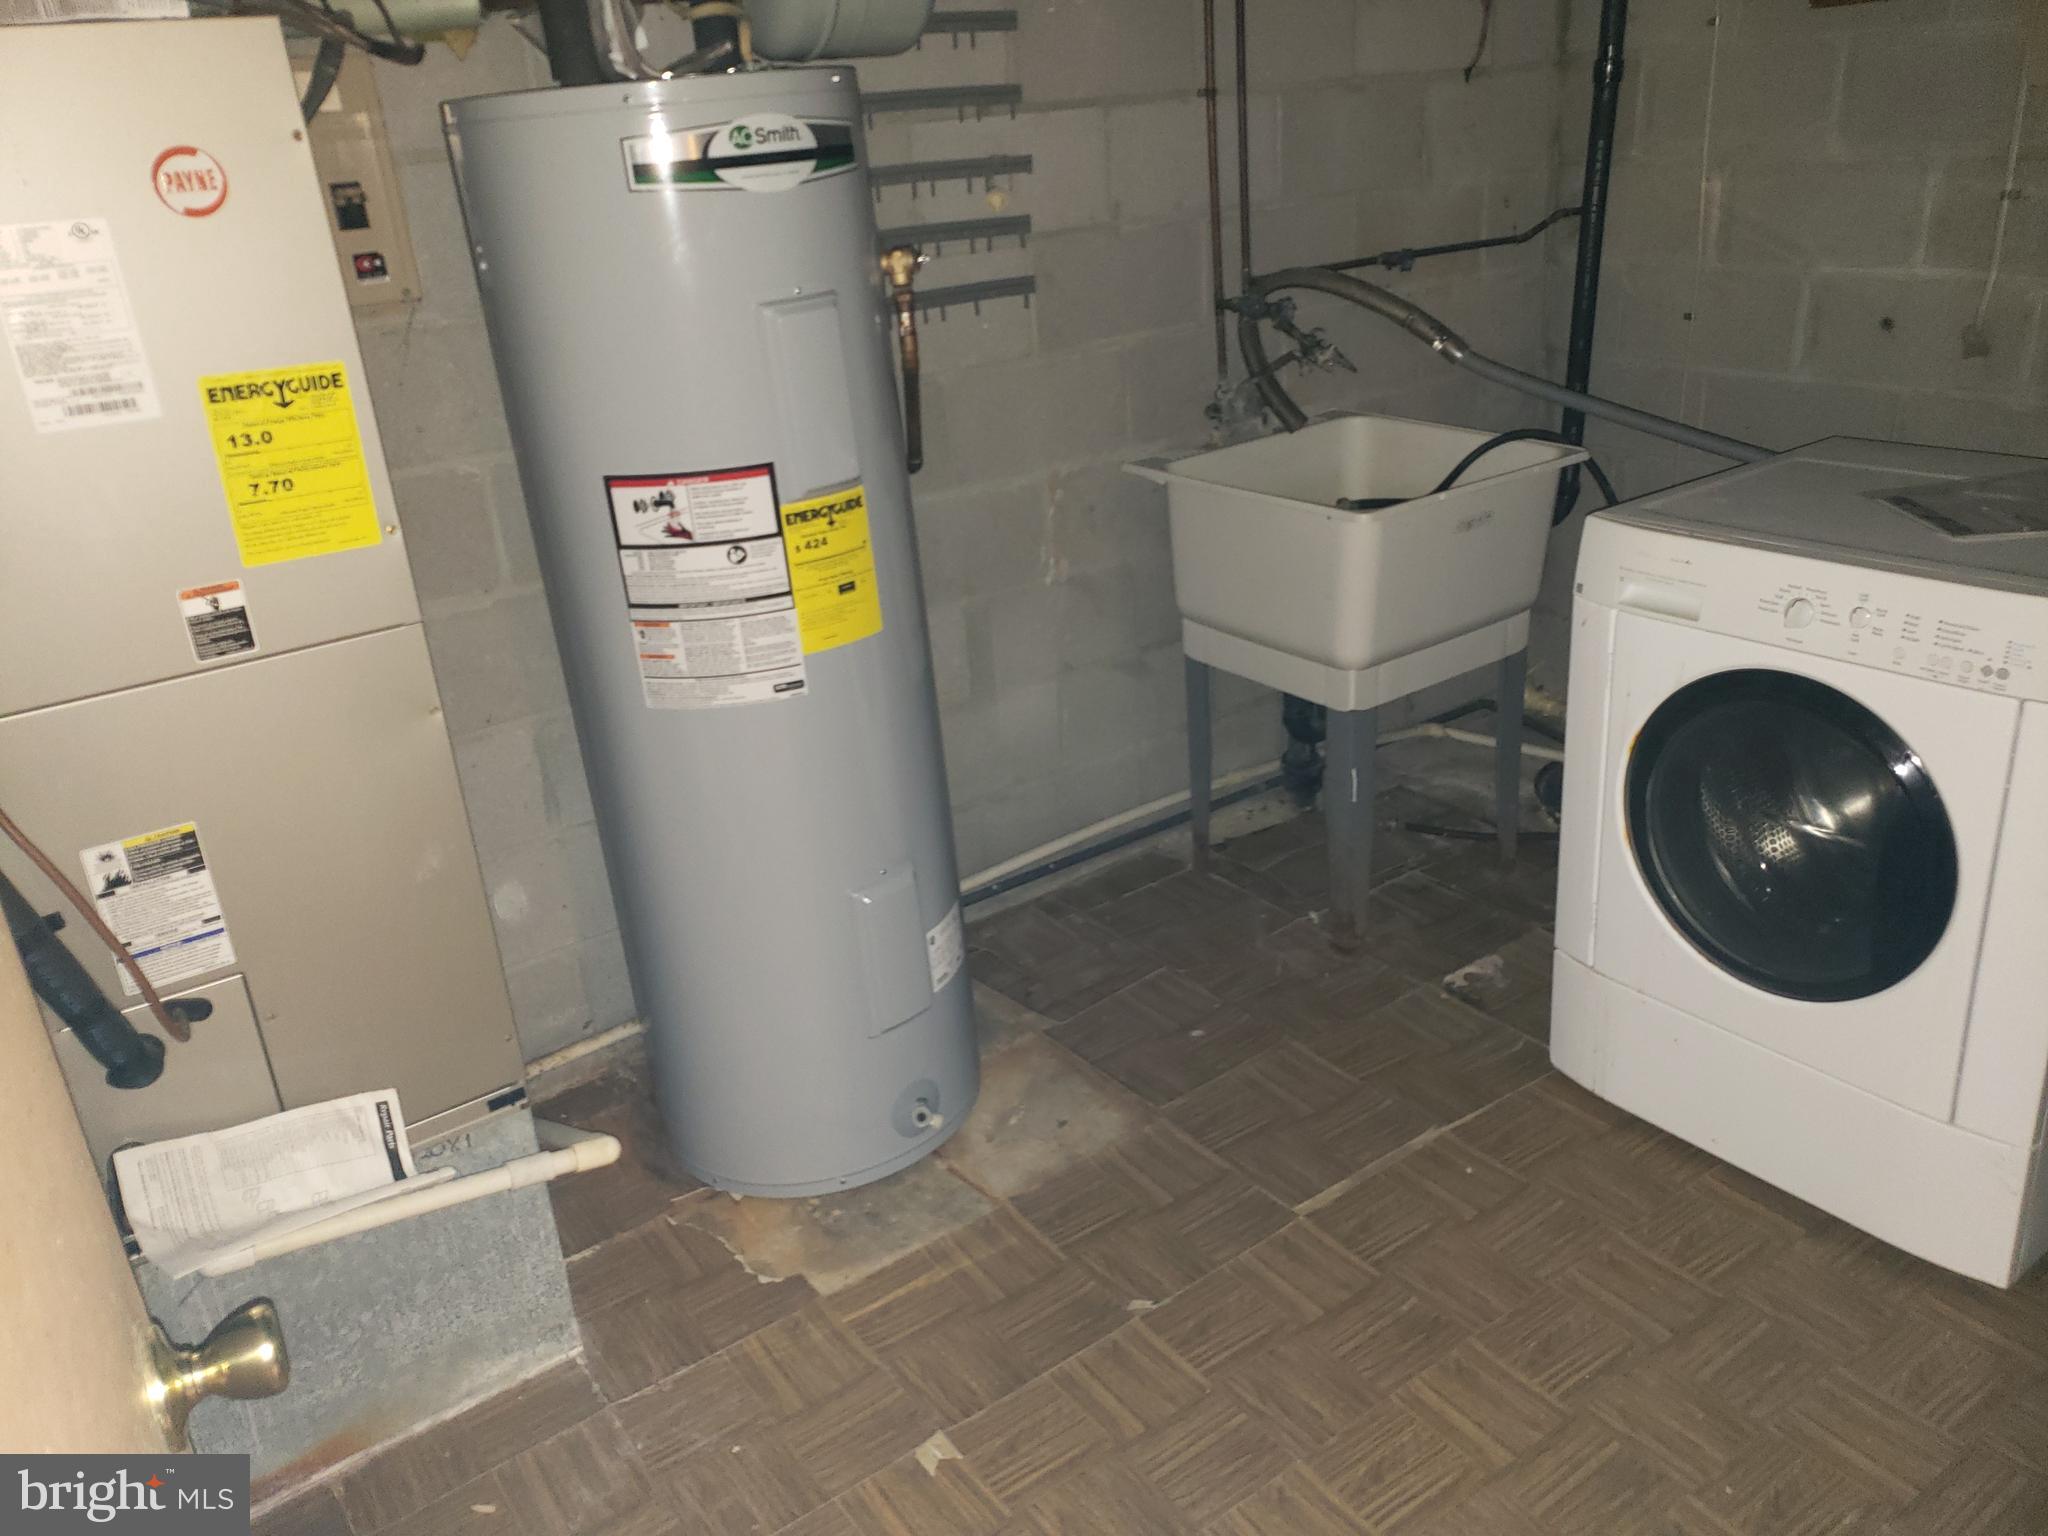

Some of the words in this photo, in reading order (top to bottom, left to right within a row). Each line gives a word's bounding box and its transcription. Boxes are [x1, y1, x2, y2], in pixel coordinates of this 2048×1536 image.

[754, 126, 800, 145] Smith
[163, 169, 218, 194] PAYNE
[226, 430, 273, 449] 13.0
[249, 478, 294, 497] 7.70
[804, 537, 828, 550] 424
